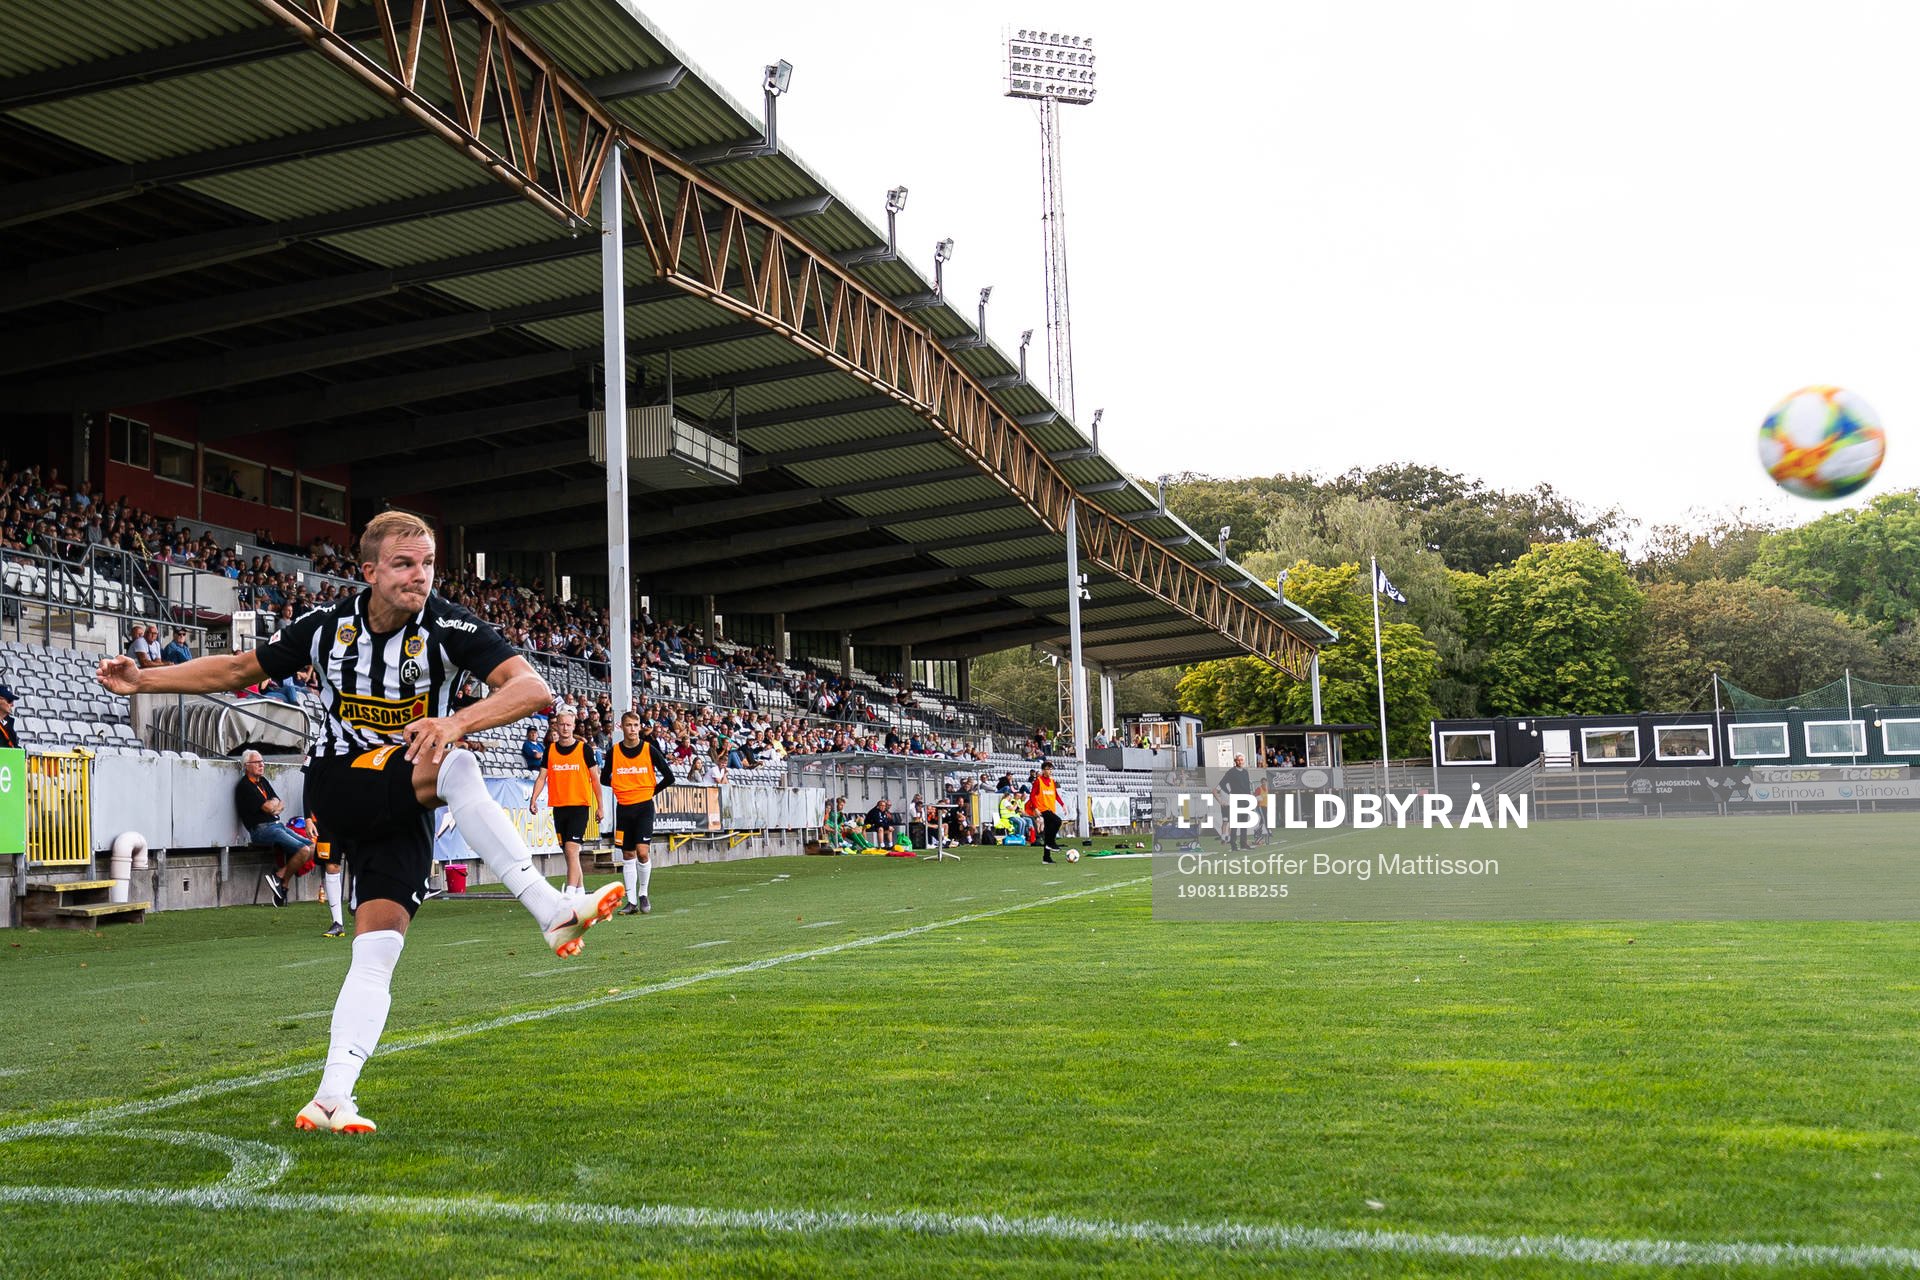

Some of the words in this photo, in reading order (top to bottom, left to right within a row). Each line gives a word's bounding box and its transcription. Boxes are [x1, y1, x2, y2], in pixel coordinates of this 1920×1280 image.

[616, 765, 649, 775] stadium
[1761, 769, 1821, 782] Tedsys
[1839, 768, 1901, 781] Tedsys
[1772, 786, 1825, 799] Brinova
[1855, 785, 1910, 797] Brinova
